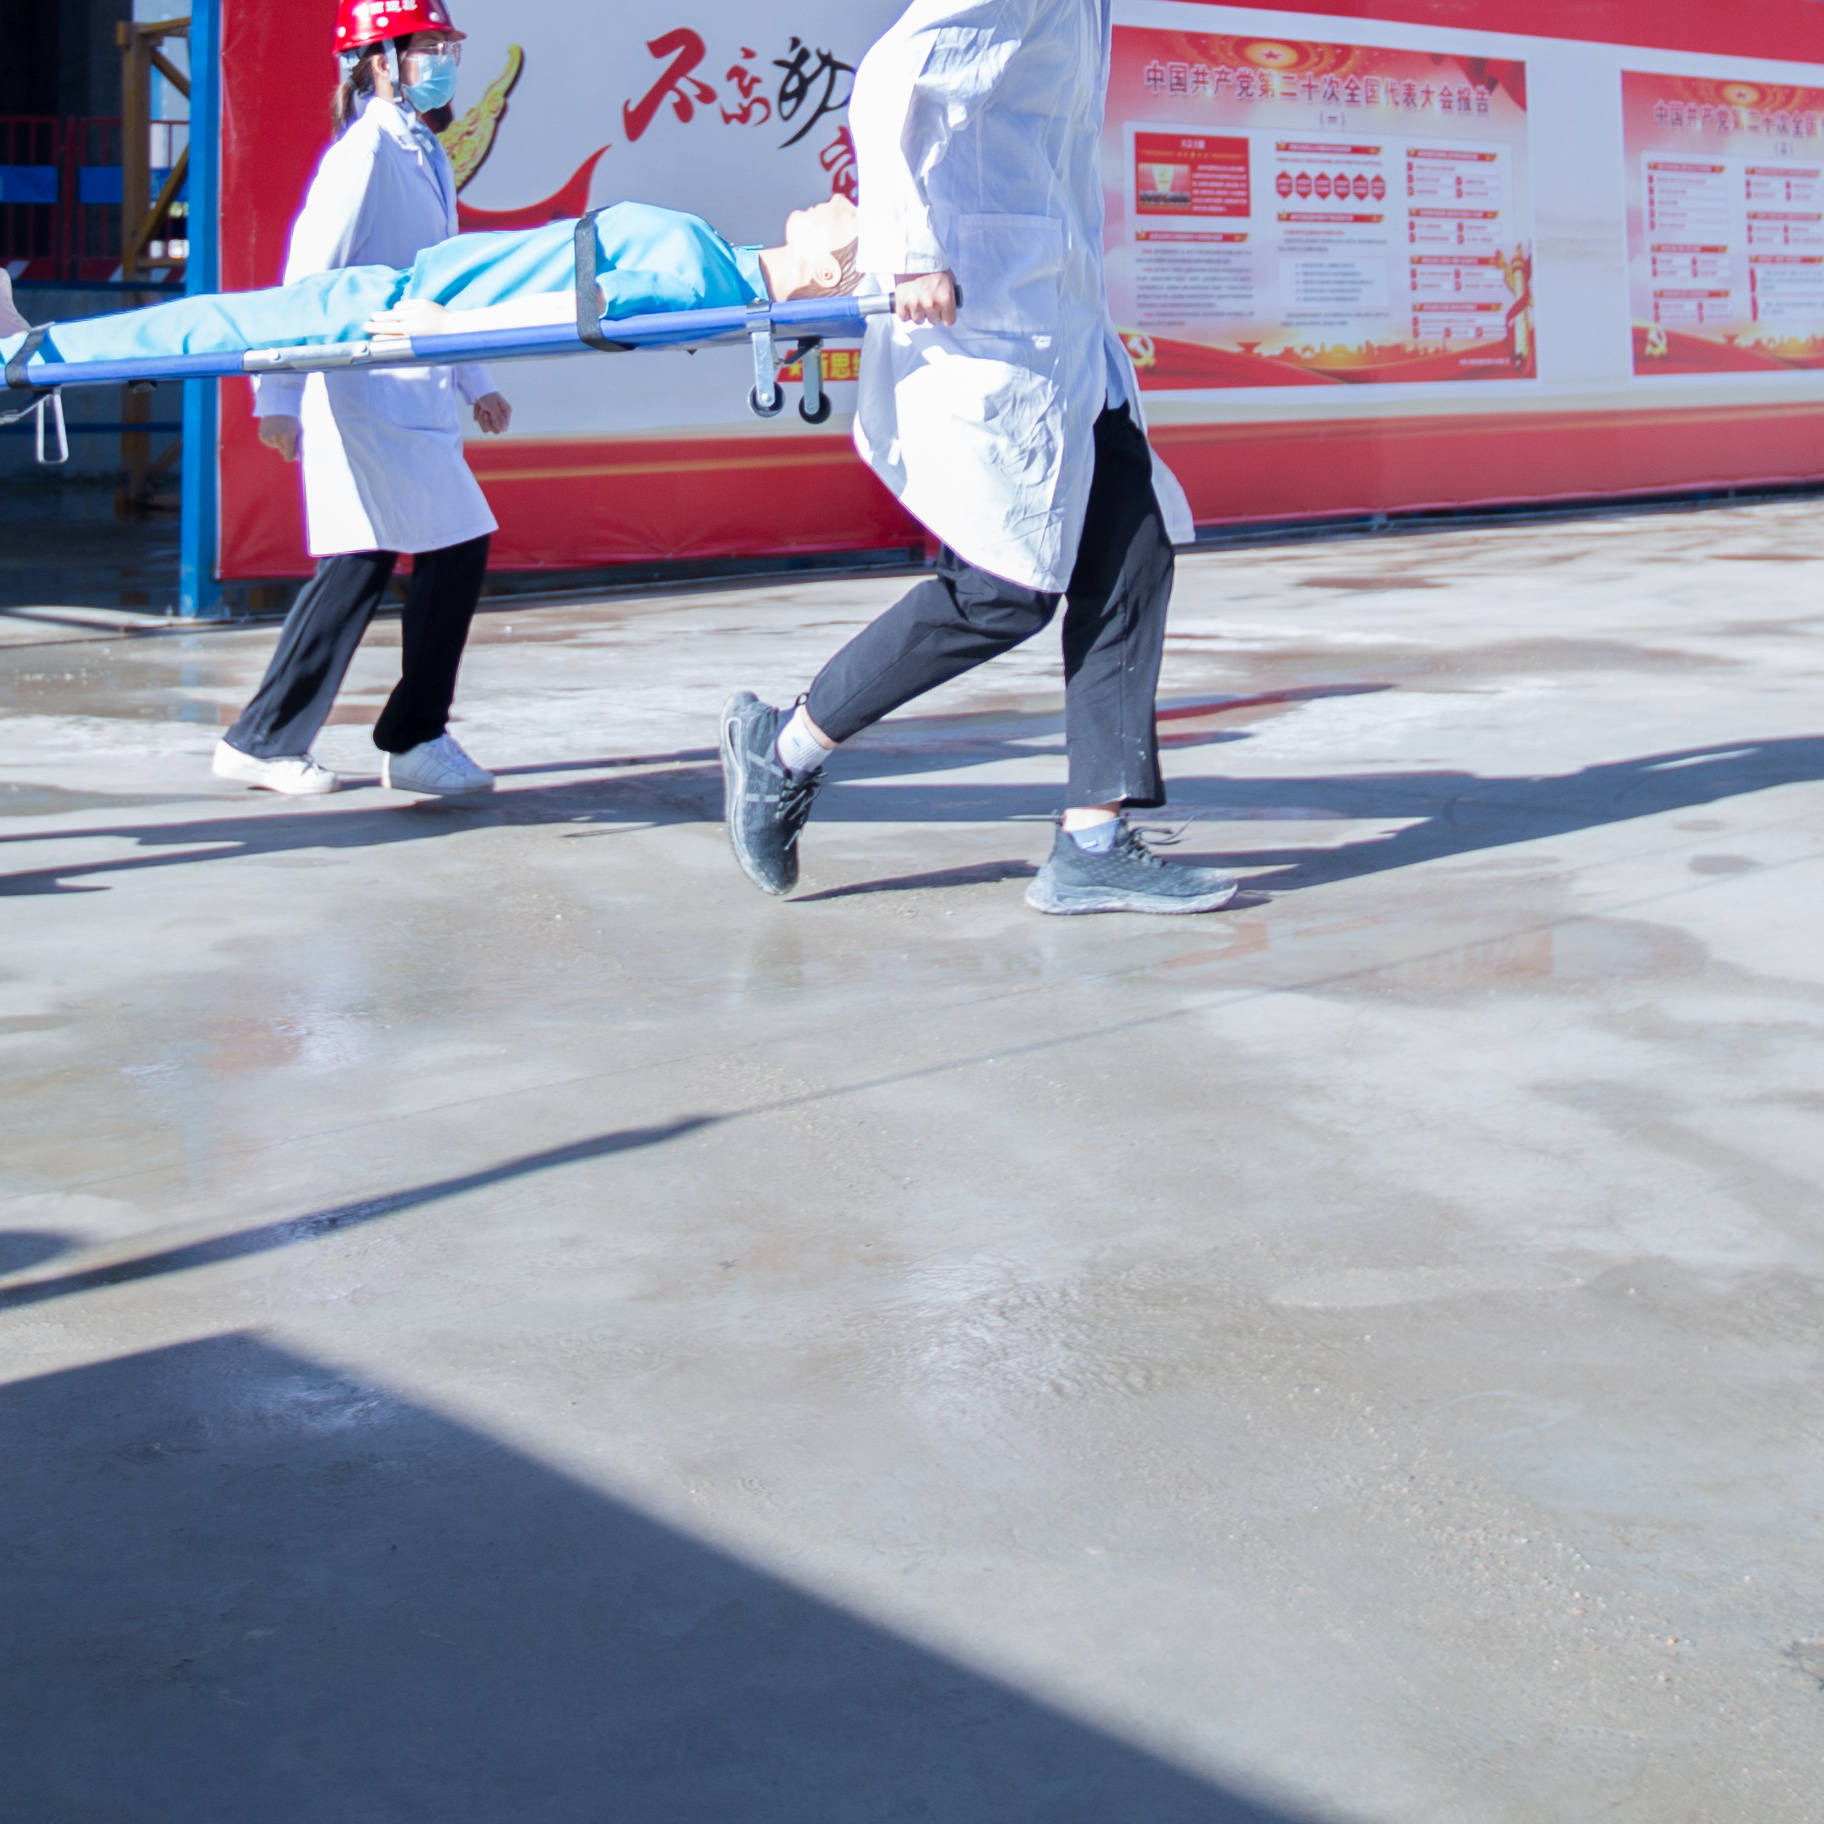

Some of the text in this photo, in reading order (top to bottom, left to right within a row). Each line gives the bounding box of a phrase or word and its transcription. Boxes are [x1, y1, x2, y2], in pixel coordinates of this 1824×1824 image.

[1143, 59, 1493, 115] 中国共产党第二十次全国代表大会报告
